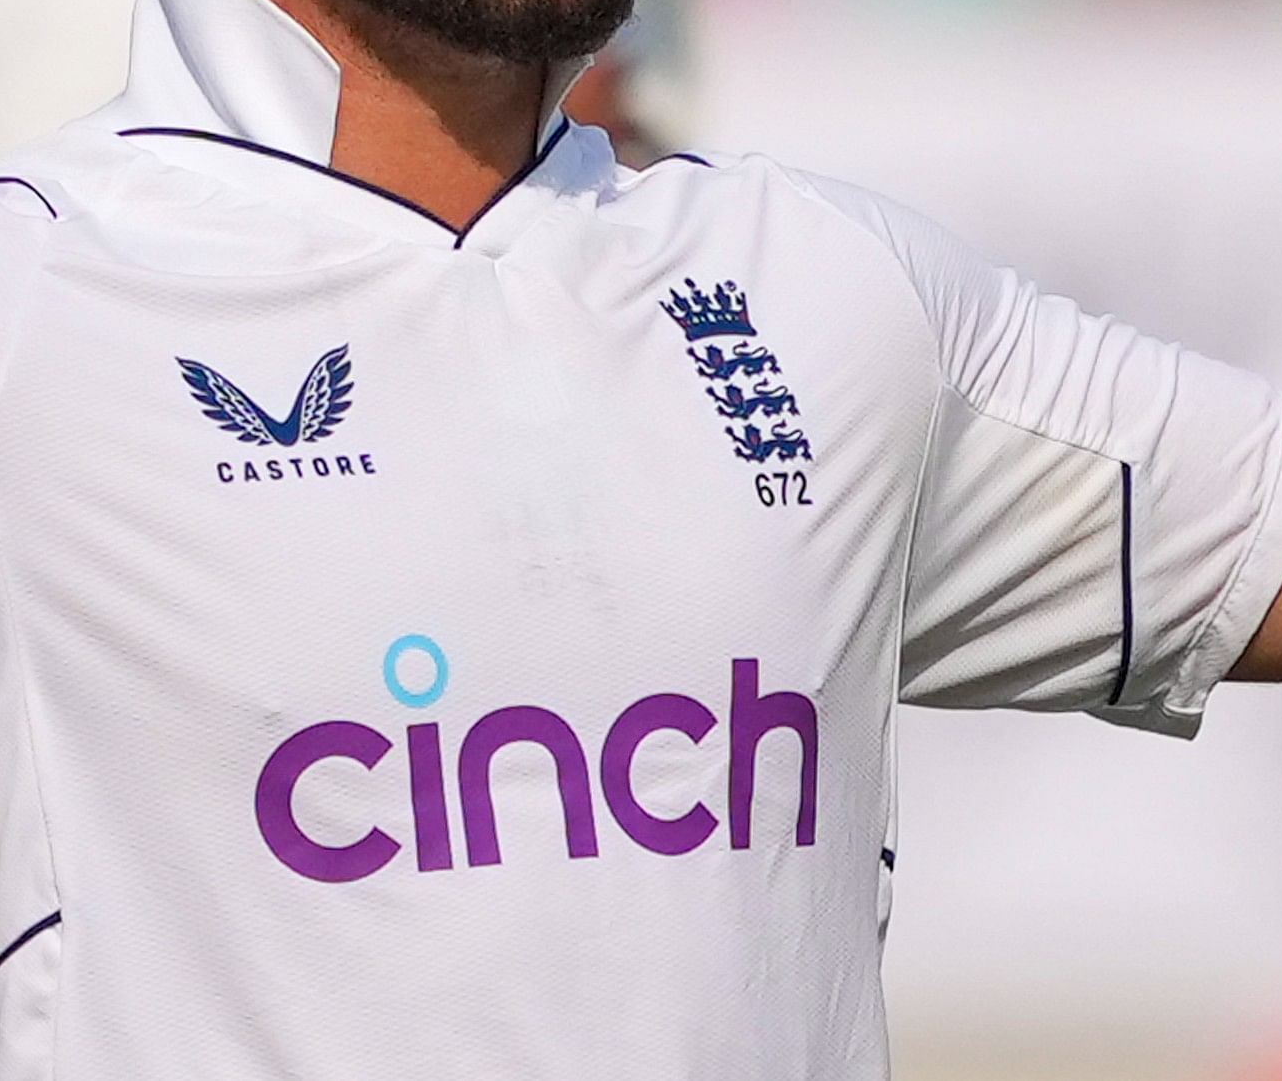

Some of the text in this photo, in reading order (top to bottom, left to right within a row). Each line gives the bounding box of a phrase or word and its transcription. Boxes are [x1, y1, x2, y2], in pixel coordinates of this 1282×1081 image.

[217, 453, 377, 484] CASTORE
[755, 471, 813, 508] 672
[255, 633, 817, 883] cinch
